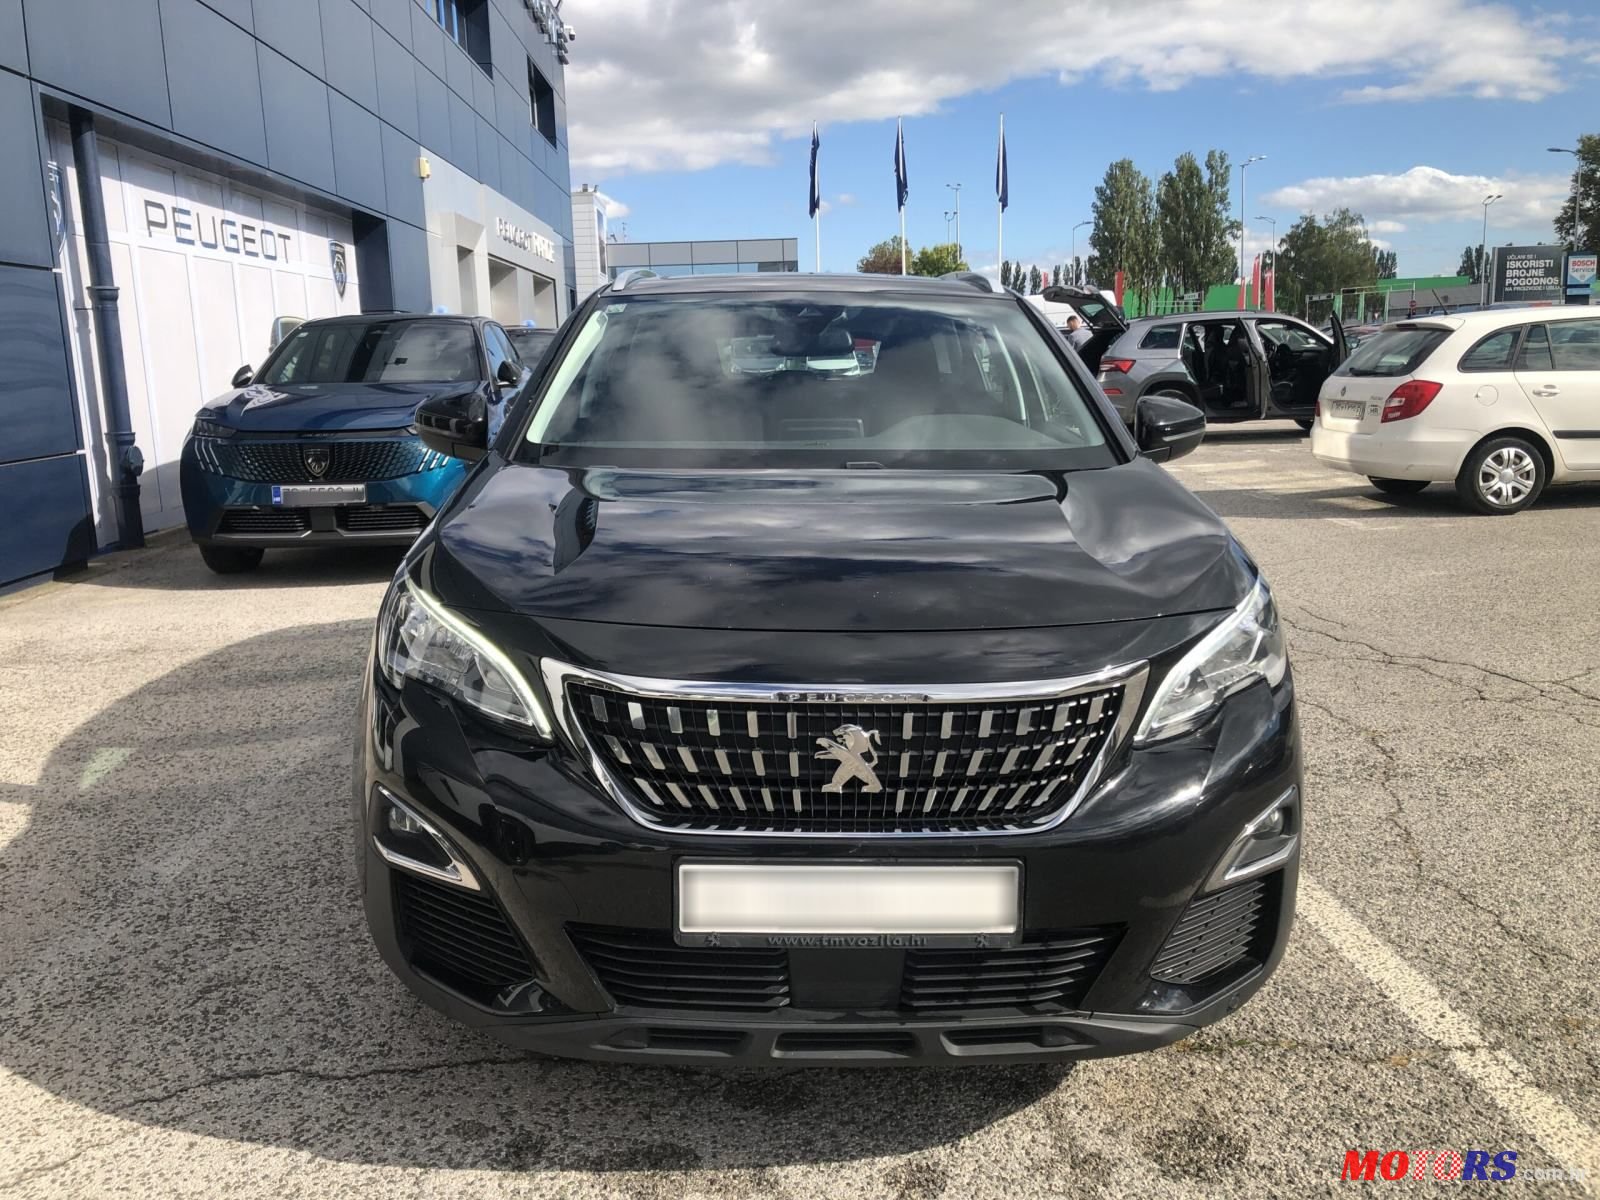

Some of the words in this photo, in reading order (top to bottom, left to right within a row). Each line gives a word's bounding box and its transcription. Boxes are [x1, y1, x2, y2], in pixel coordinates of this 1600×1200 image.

[144, 199, 291, 264] PEUGEOT
[1506, 260, 1554, 269] ISKORISTI
[1571, 259, 1596, 267] BOSCH
[1506, 269, 1545, 278] BROJNE
